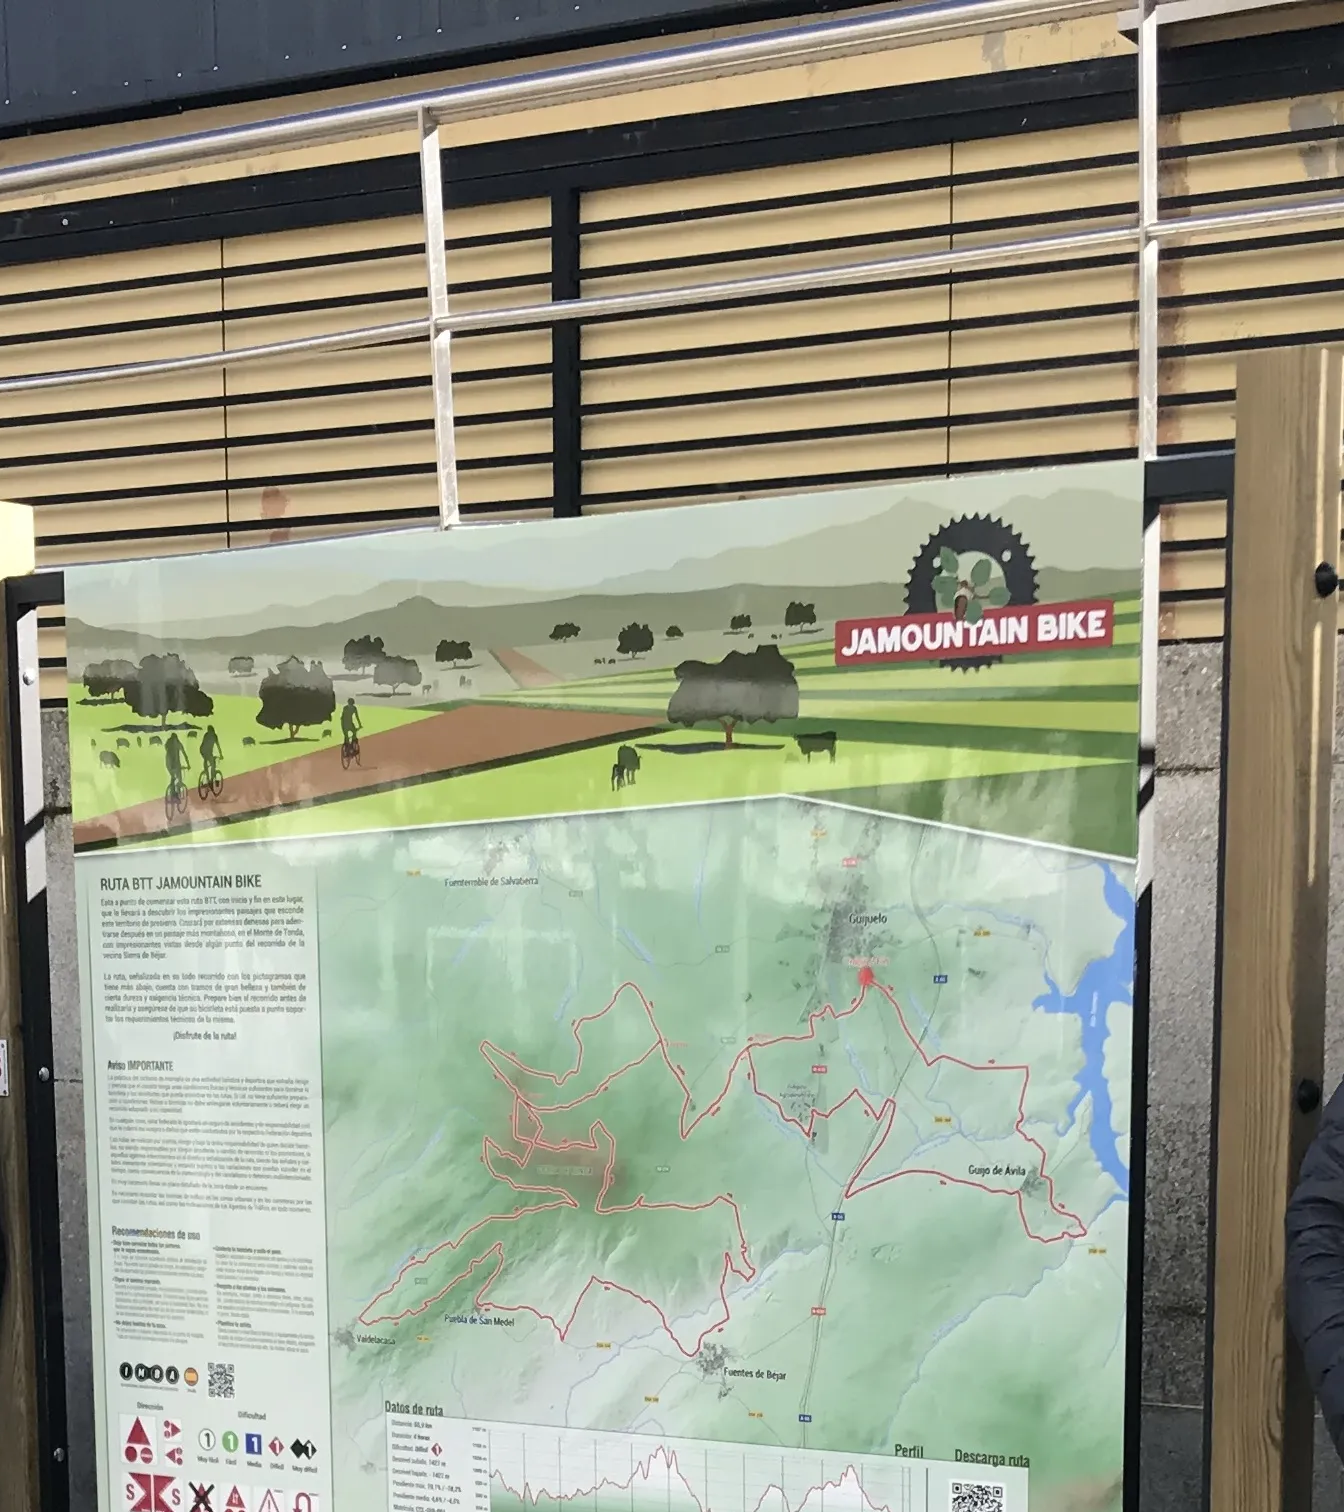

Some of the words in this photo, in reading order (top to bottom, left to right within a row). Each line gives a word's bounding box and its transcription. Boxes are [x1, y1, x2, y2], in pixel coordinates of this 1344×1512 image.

[841, 614, 1028, 657] JAMOUNTAIN
[1037, 609, 1107, 642] BIKE
[100, 877, 130, 891] RUTA
[132, 876, 153, 890] BTT
[156, 875, 232, 890] JAMOUNTAIN
[236, 874, 262, 888] BIKE
[490, 877, 499, 886] de
[849, 912, 888, 927] Guijuelo
[203, 1031, 211, 1040] de
[213, 1031, 220, 1040] la
[108, 1060, 126, 1070] Aviso
[127, 1060, 174, 1071] IMPORTANTE
[968, 1164, 991, 1178] Guijo
[992, 1164, 1003, 1175] de
[177, 1230, 186, 1240] de
[469, 1315, 477, 1324] de
[478, 1316, 493, 1326] San
[494, 1317, 515, 1327] Medel
[357, 1334, 396, 1345] Valdelacasa
[723, 1367, 754, 1380] Fuentes
[755, 1369, 765, 1379] de
[384, 1400, 410, 1414] Datos
[412, 1403, 423, 1415] de
[426, 1405, 444, 1416] ruta
[894, 1443, 924, 1459] Perfil
[955, 1449, 1005, 1467] Descarga
[1008, 1454, 1031, 1468] ruta
[125, 1483, 135, 1501] S
[171, 1488, 181, 1506] S
